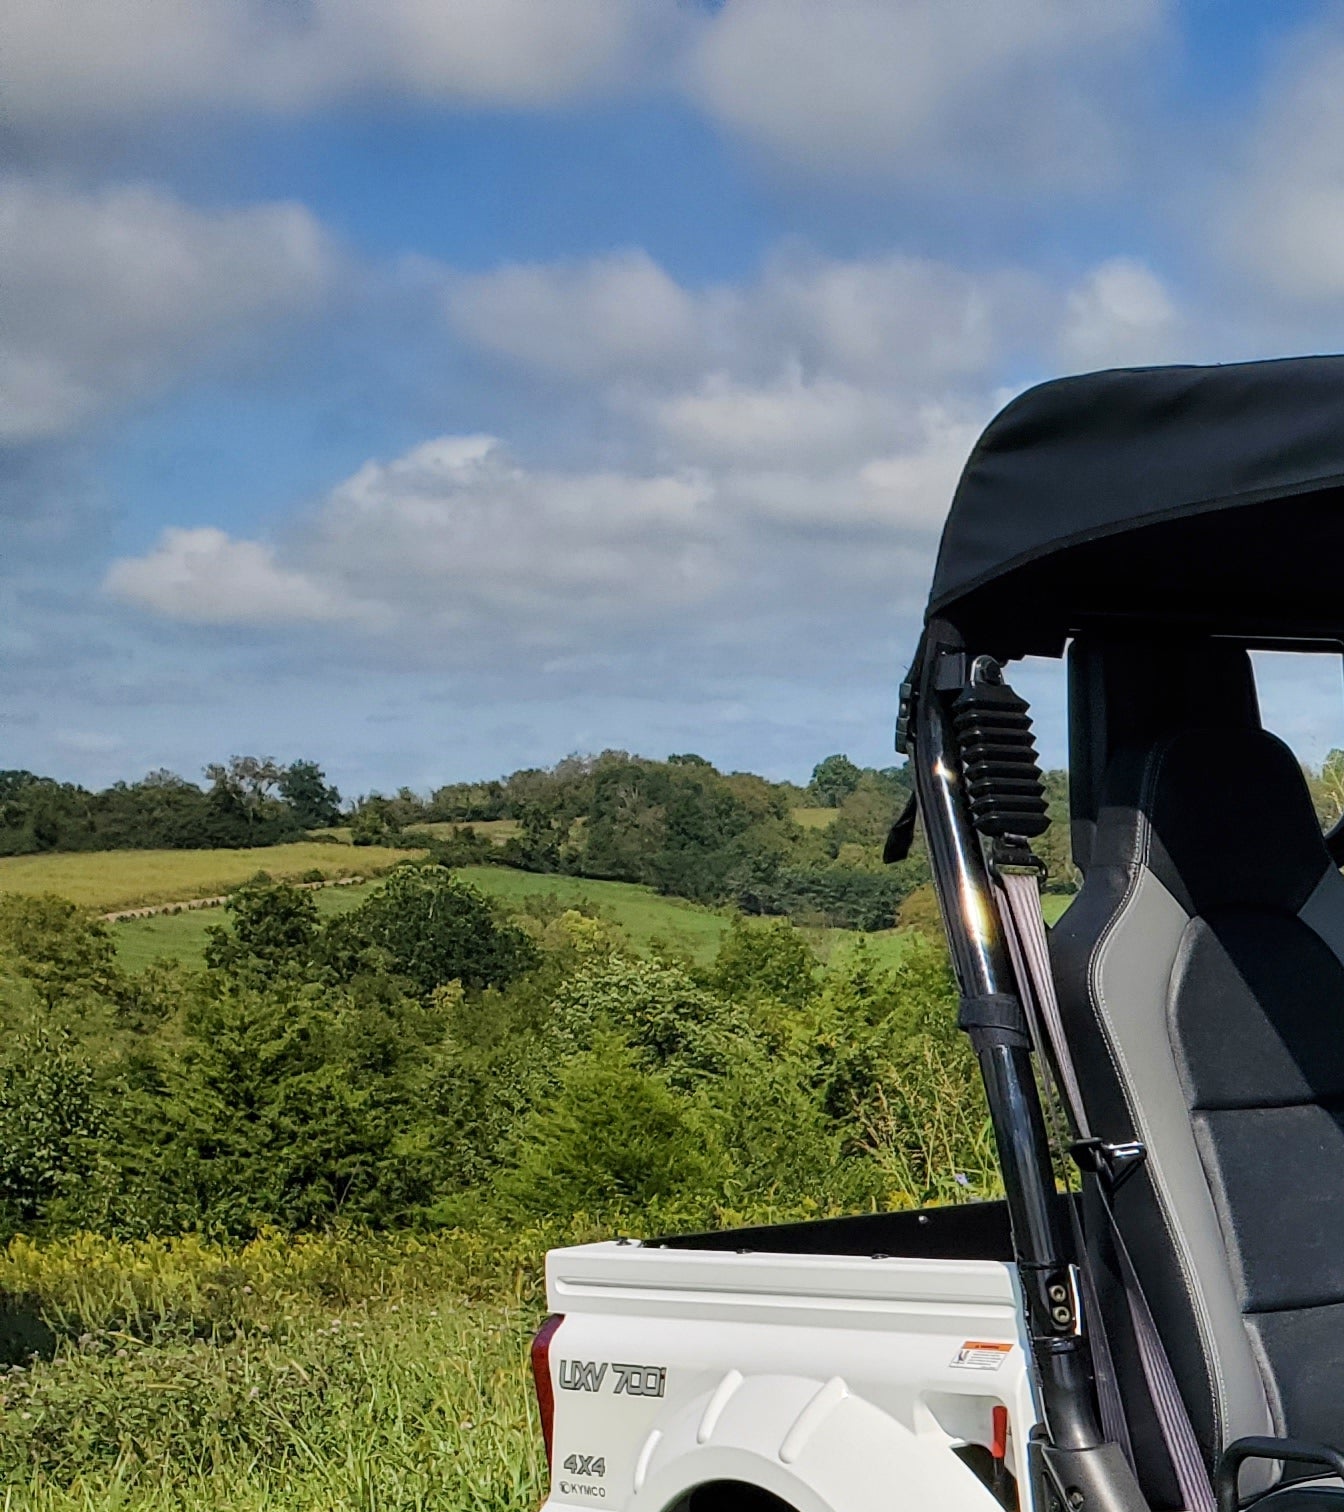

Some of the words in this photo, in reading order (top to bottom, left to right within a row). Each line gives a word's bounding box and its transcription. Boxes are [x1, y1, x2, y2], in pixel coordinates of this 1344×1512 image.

[559, 1359, 609, 1392] UXV
[611, 1363, 667, 1398] 700i
[563, 1454, 606, 1477] 4X4
[570, 1483, 606, 1498] KYMCO
